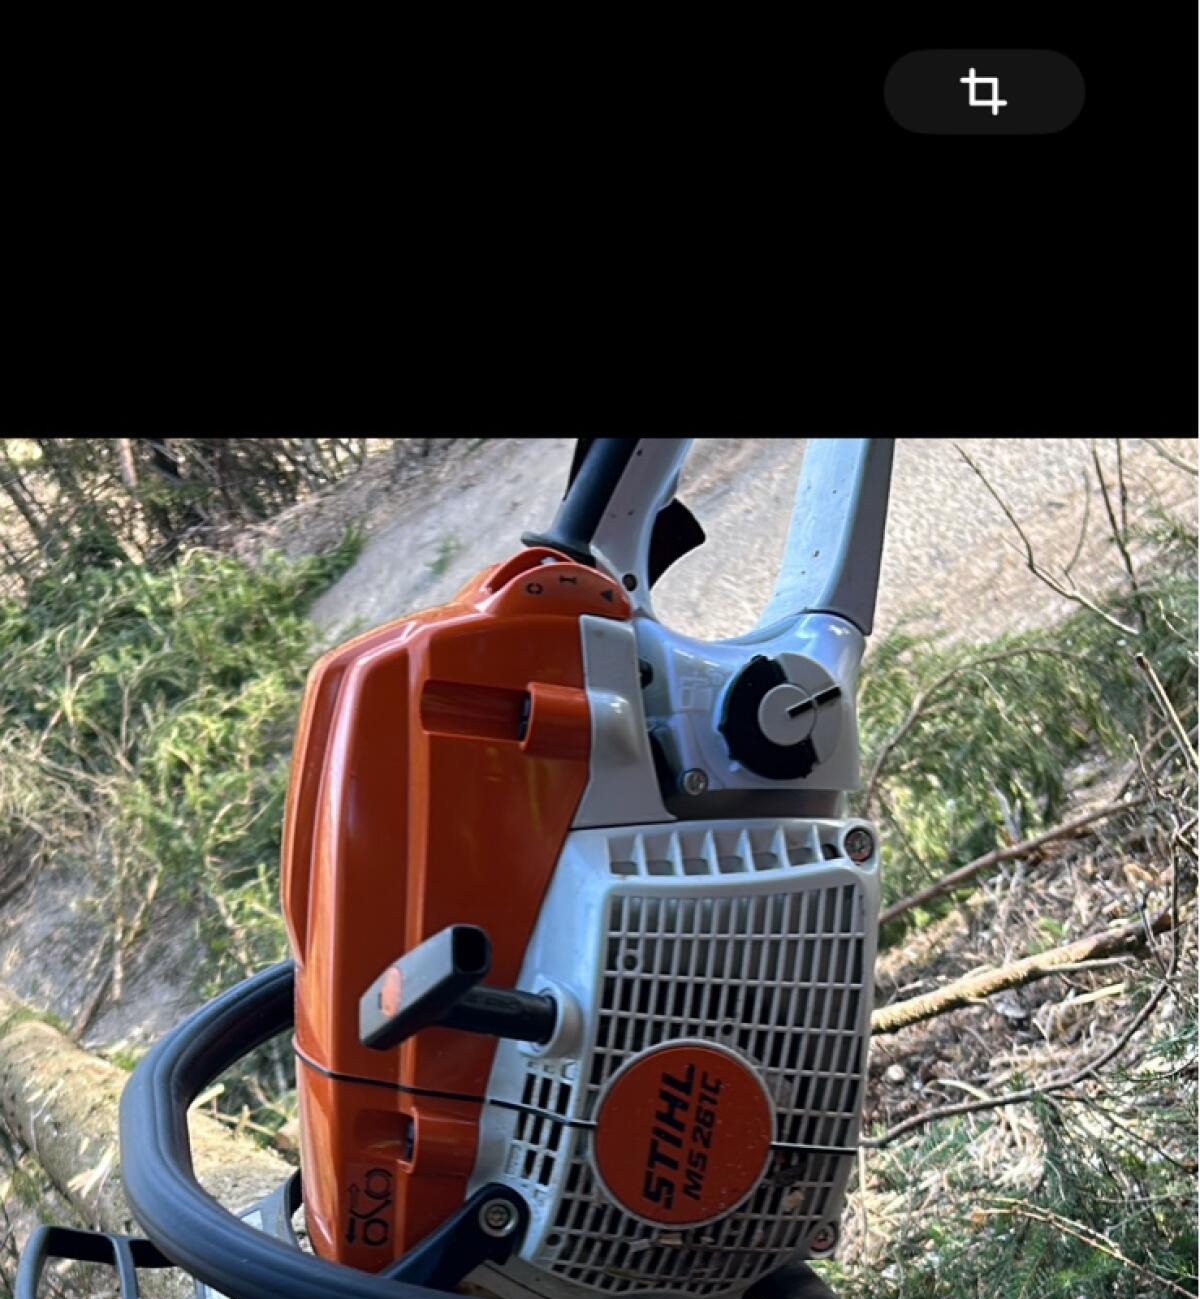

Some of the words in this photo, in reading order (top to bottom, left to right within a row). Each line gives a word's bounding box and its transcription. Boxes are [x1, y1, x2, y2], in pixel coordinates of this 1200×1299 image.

[643, 1063, 696, 1210] STIHL
[692, 1071, 723, 1149] 261C
[683, 1150, 709, 1201] MS
